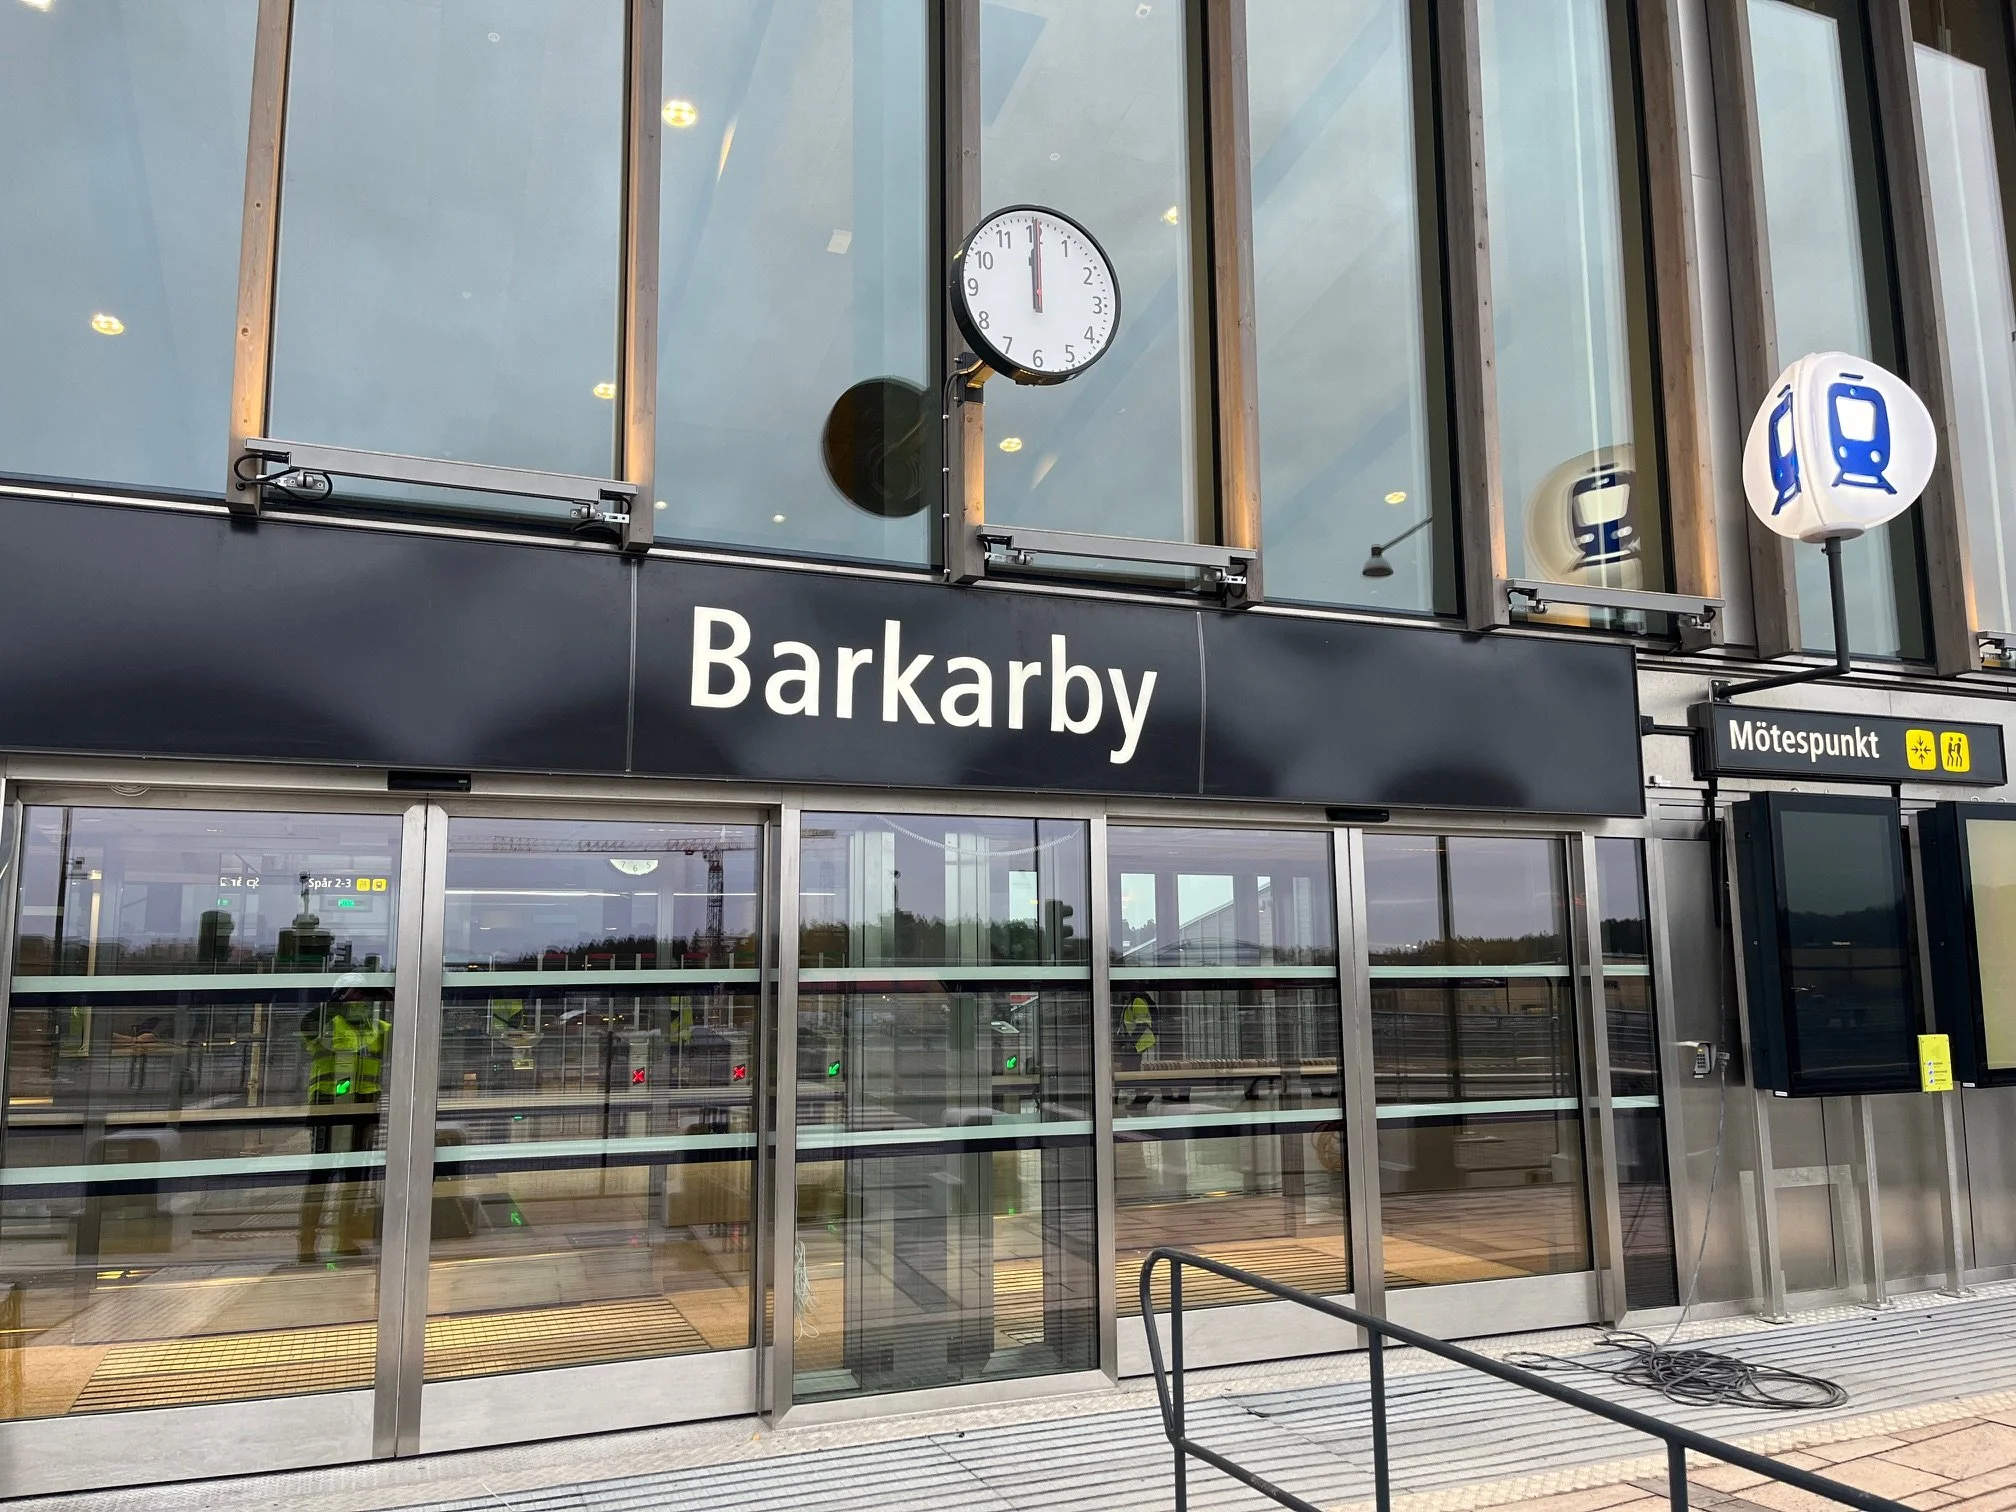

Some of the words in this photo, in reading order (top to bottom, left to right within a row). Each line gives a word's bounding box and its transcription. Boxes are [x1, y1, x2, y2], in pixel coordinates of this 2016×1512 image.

[996, 229, 1012, 249] 11
[1061, 239, 1069, 258] 1
[975, 250, 994, 270] 10
[1082, 266, 1093, 285] 2
[967, 277, 979, 297] 9
[1092, 296, 1103, 314] 3
[978, 310, 990, 330] 8
[1002, 335, 1013, 354] 7
[1084, 326, 1095, 344] 4
[1032, 349, 1044, 368] 6
[1065, 344, 1075, 363] 5
[690, 605, 1158, 765] Barkarby
[1728, 719, 1880, 763] Mötespunkt
[308, 877, 333, 890] Spår
[334, 878, 352, 888] 2-3
